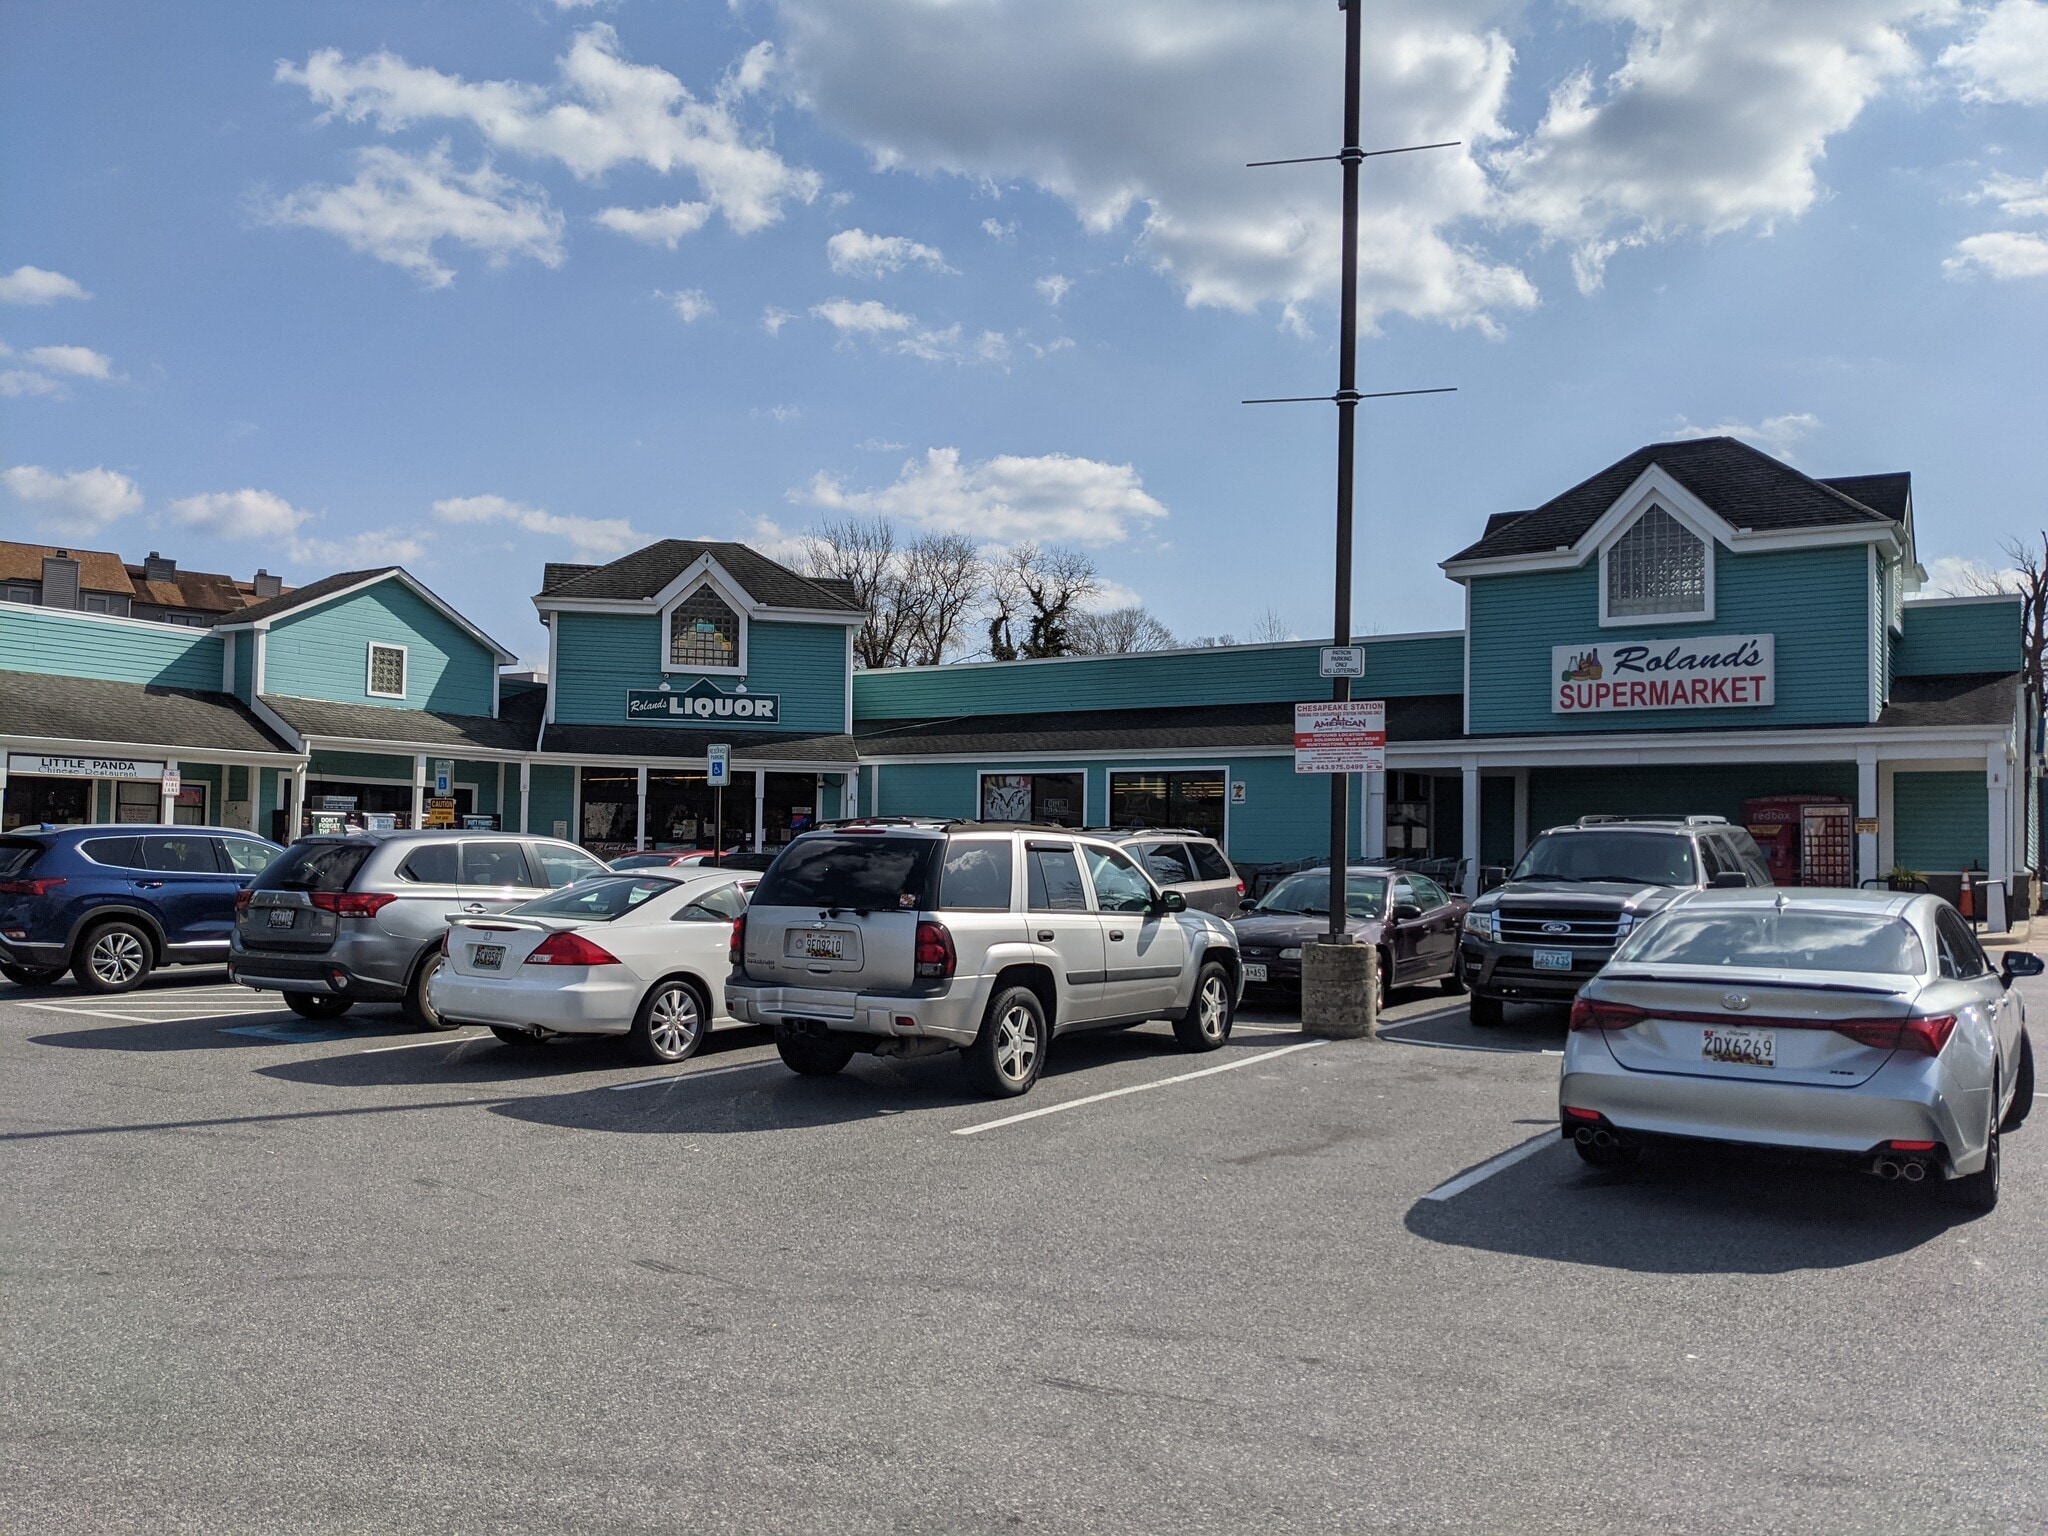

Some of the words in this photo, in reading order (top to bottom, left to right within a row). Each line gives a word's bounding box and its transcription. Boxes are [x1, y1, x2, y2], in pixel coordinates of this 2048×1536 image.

[1613, 639, 1763, 676] Roland's
[1559, 676, 1766, 710] SUPERMARKET
[631, 698, 667, 713] Rolands
[669, 697, 774, 718] LIQUOR
[1297, 704, 1348, 712] CHESAPEAKE
[1313, 719, 1366, 729] AMERICAN
[41, 758, 86, 769] LITTLE
[93, 760, 135, 771] PANDA
[38, 766, 80, 774] Chinese
[85, 768, 138, 778] Restaurant
[432, 800, 453, 808] CAUTION
[1753, 811, 1791, 820] redbox
[1704, 1036, 1772, 1057] 2DX6269
